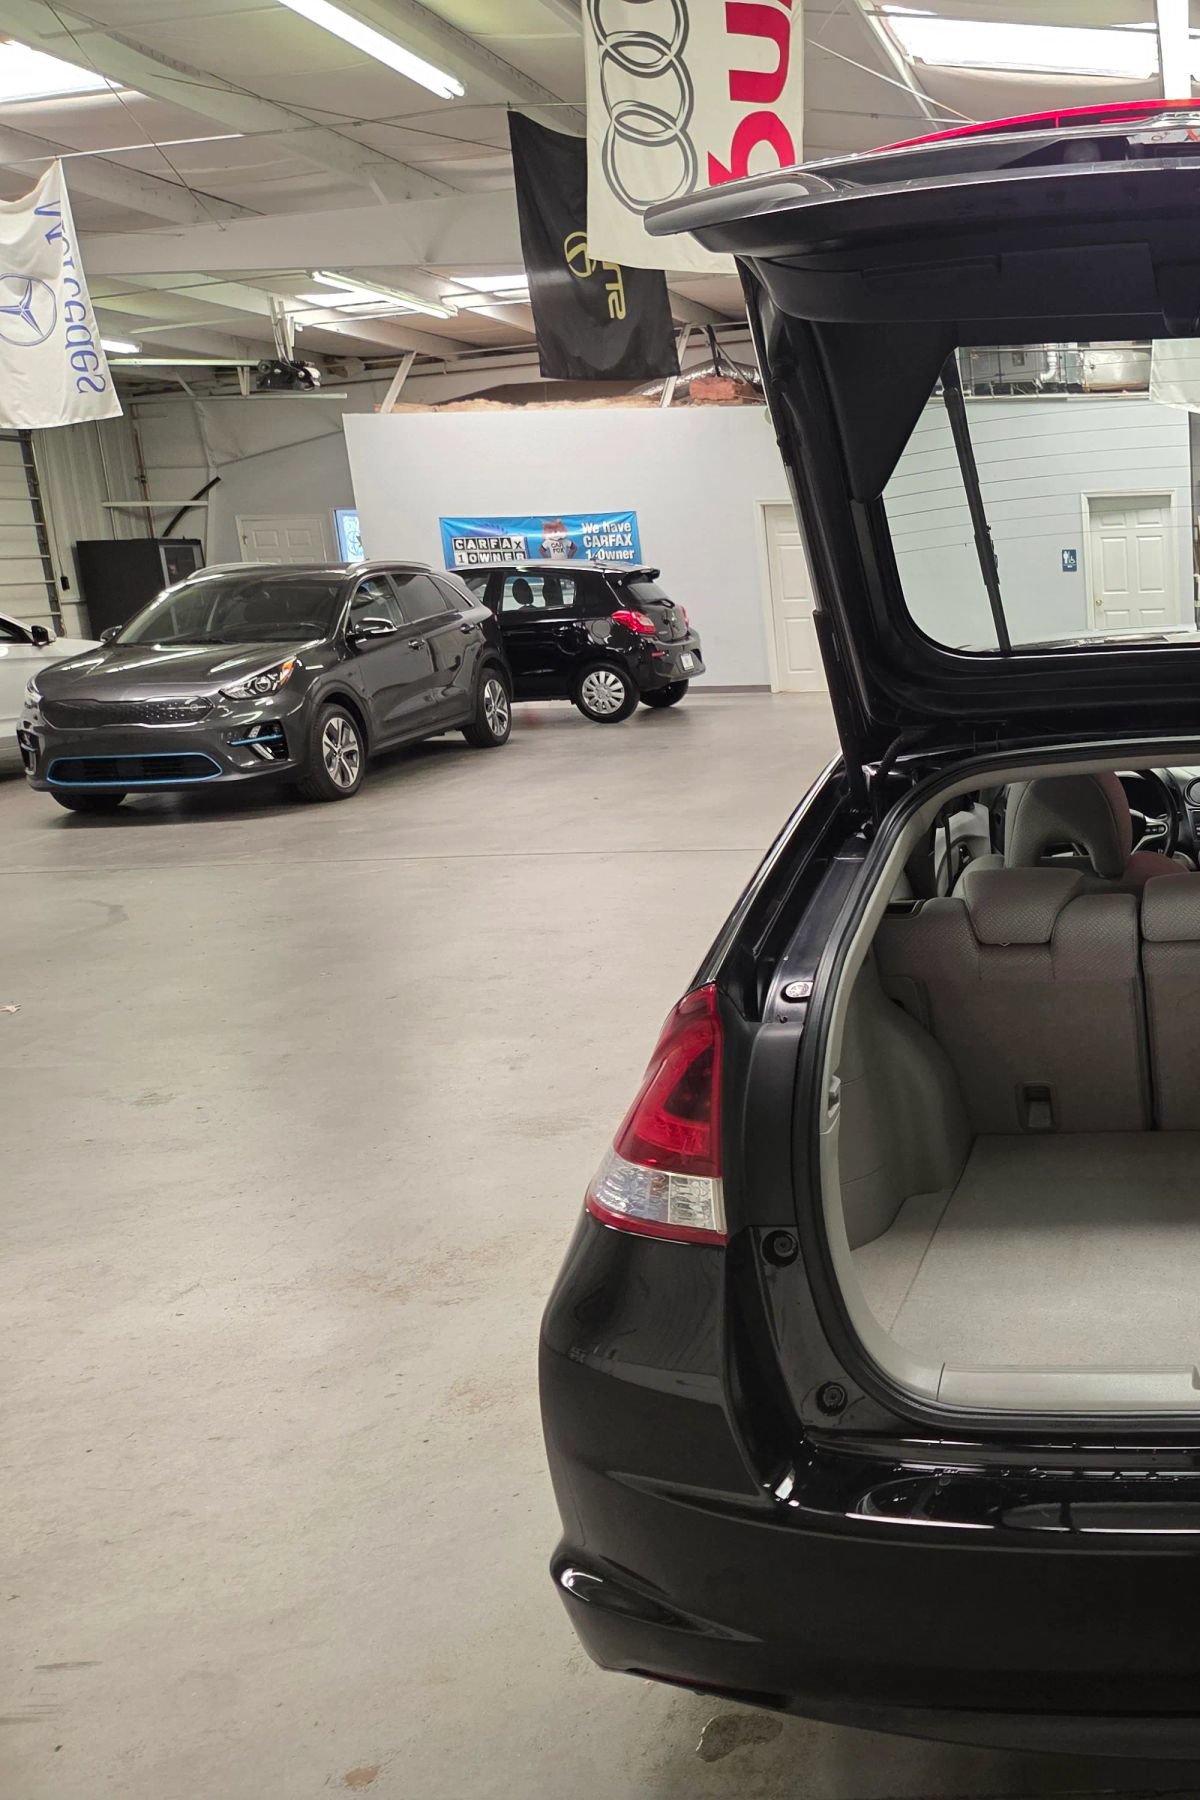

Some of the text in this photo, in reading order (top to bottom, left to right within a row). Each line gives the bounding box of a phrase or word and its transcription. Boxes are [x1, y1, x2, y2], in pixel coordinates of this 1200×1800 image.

[581, 520, 632, 534] We have
[454, 538, 524, 550] CARFAX
[582, 533, 633, 549] CARFAX
[468, 552, 525, 564] OWNER
